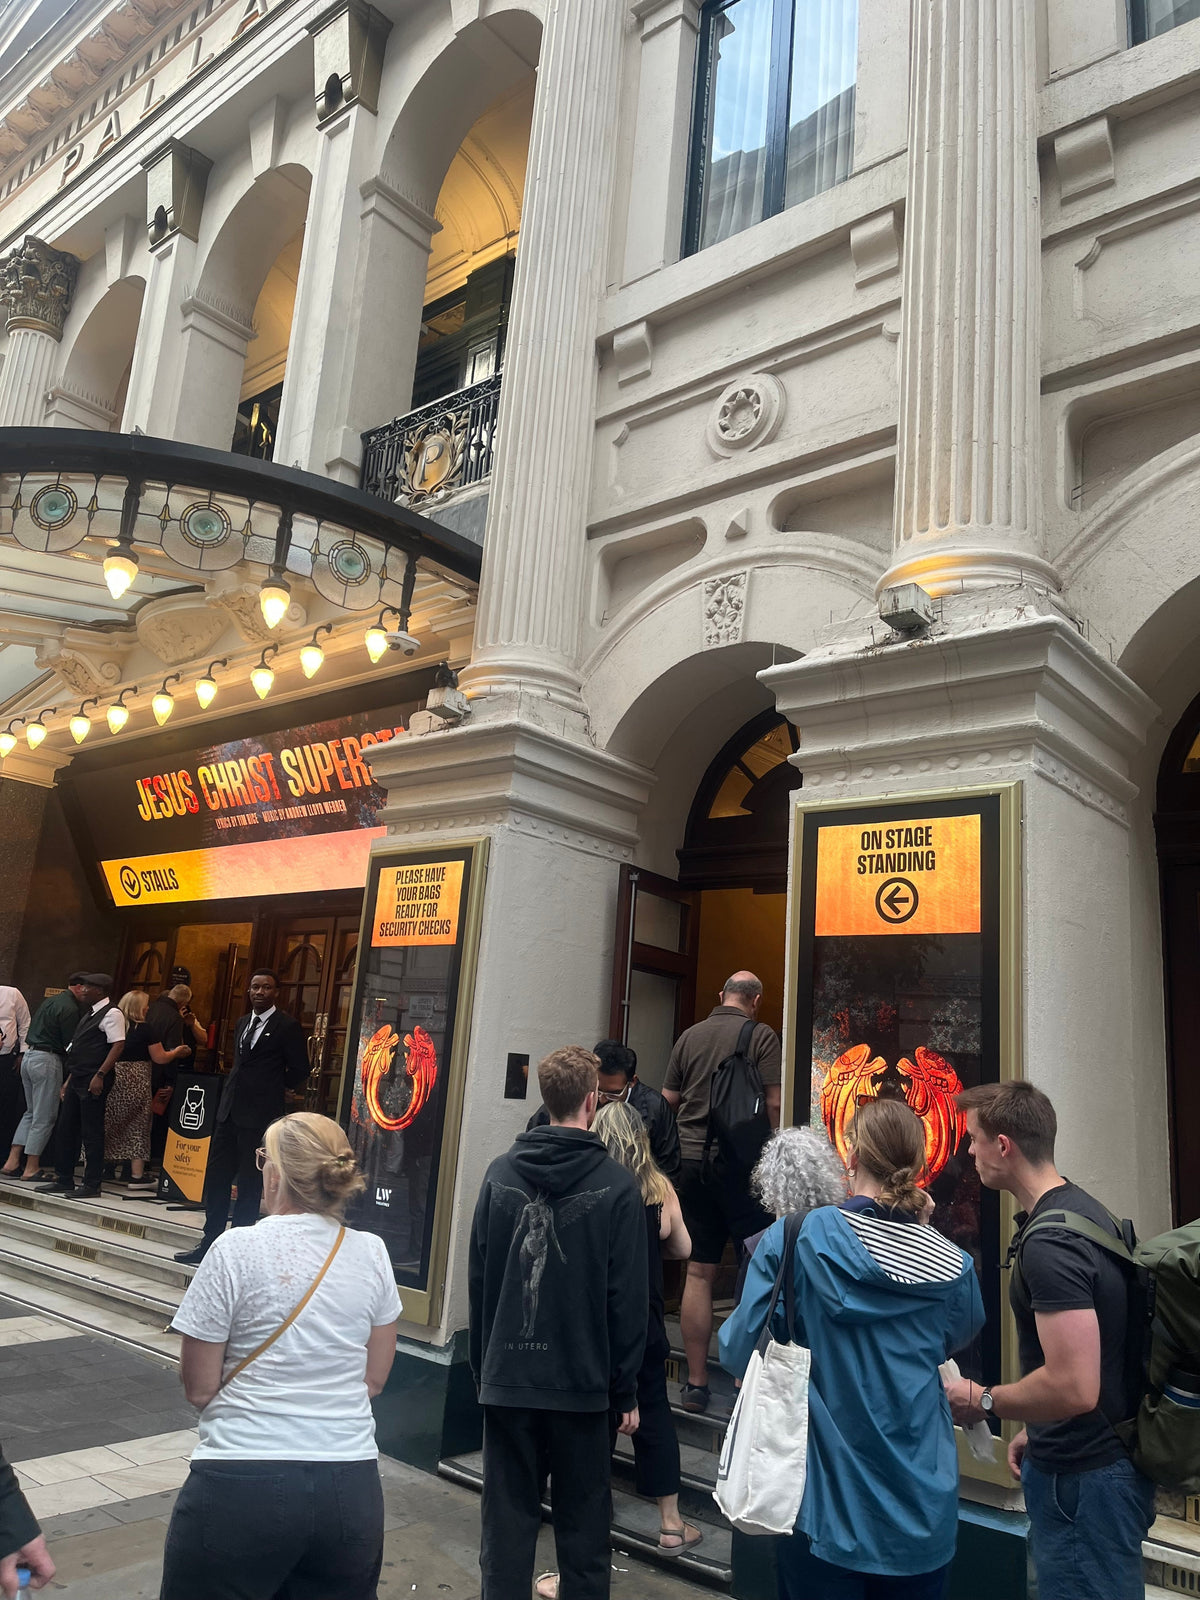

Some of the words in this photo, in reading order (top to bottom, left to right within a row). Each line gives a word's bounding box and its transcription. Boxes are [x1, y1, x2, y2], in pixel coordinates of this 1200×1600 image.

[418, 442, 445, 485] P
[136, 769, 200, 821] JESUS
[197, 753, 282, 811] CHRIST
[280, 726, 405, 798] SUPER
[861, 830, 882, 850] ON
[886, 826, 932, 848] STAGE
[857, 850, 936, 874] STANDING
[140, 867, 179, 893] STALLS
[395, 868, 424, 885] PLEASE
[425, 867, 446, 882] HAVE
[397, 886, 418, 902] YOUR
[419, 884, 441, 900] BAGS
[395, 903, 421, 919] READY
[422, 902, 438, 918] FOR
[379, 921, 418, 937] SECURITY
[418, 919, 451, 935] CHECKS
[176, 1140, 186, 1150] For
[186, 1144, 201, 1153] your
[174, 1153, 190, 1165] safety
[505, 1342, 514, 1350] IN
[518, 1342, 548, 1350] UTERO
